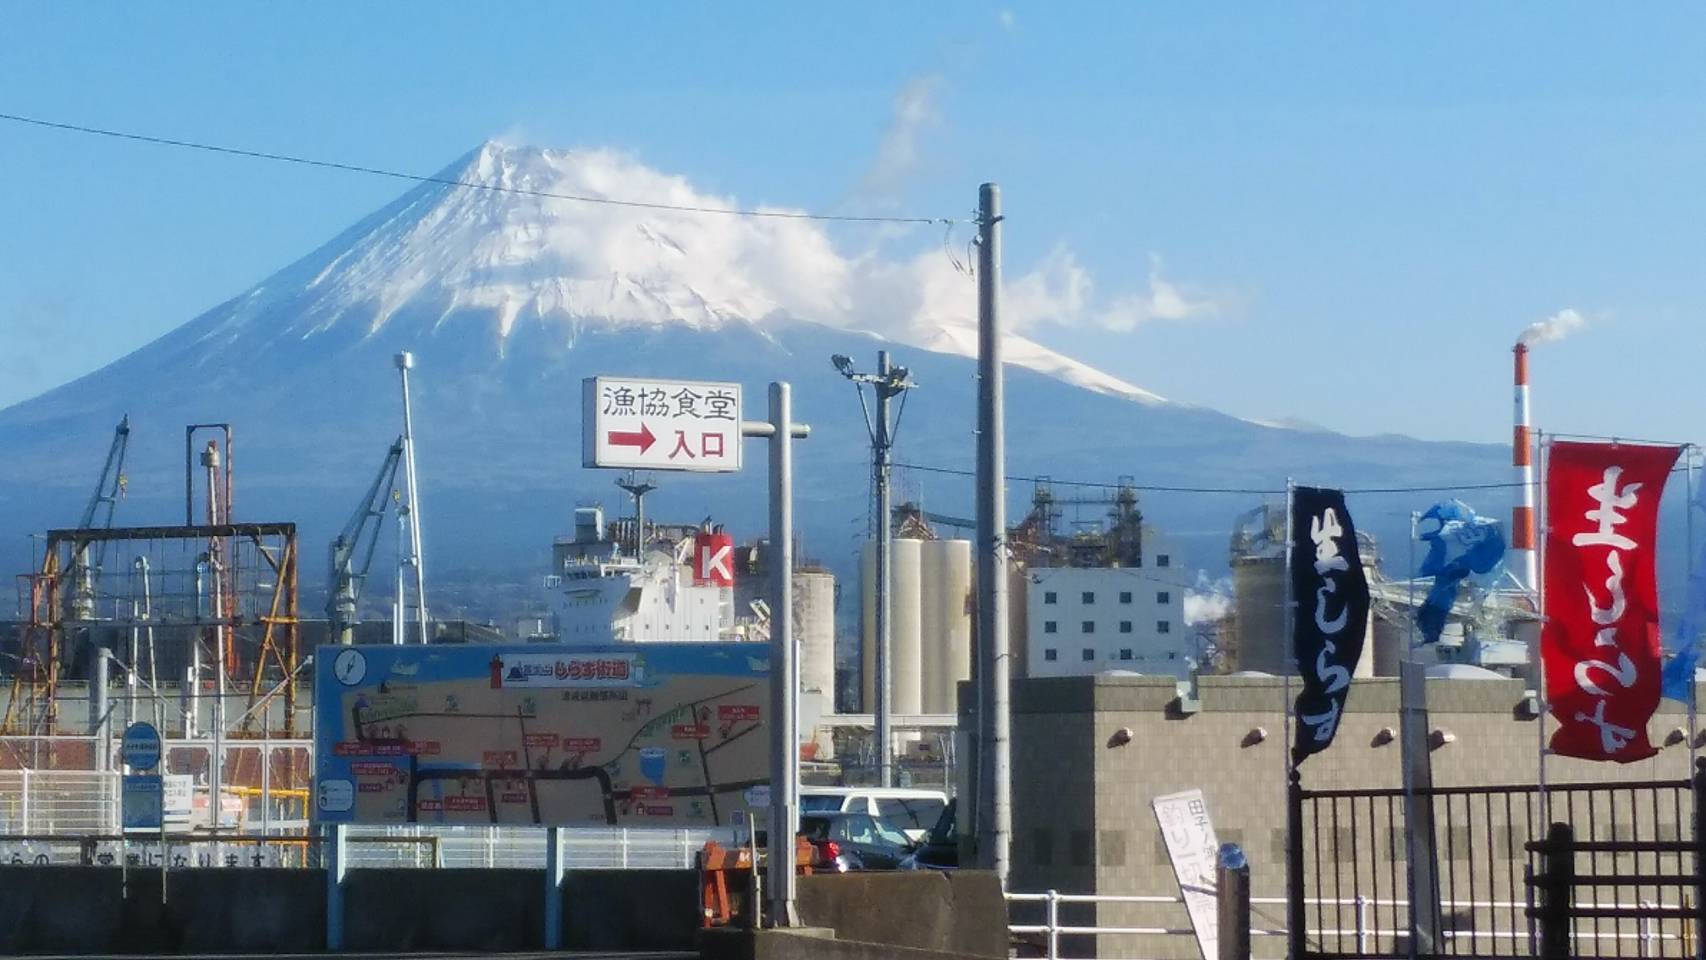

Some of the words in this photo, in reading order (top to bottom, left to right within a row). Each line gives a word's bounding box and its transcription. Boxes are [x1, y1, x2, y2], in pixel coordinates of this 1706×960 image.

[603, 386, 736, 421] 漁協食堂
[668, 430, 724, 459] 入口
[702, 545, 733, 580] K
[1300, 506, 1352, 742] 生しらす
[1572, 465, 1643, 754] 生しらす
